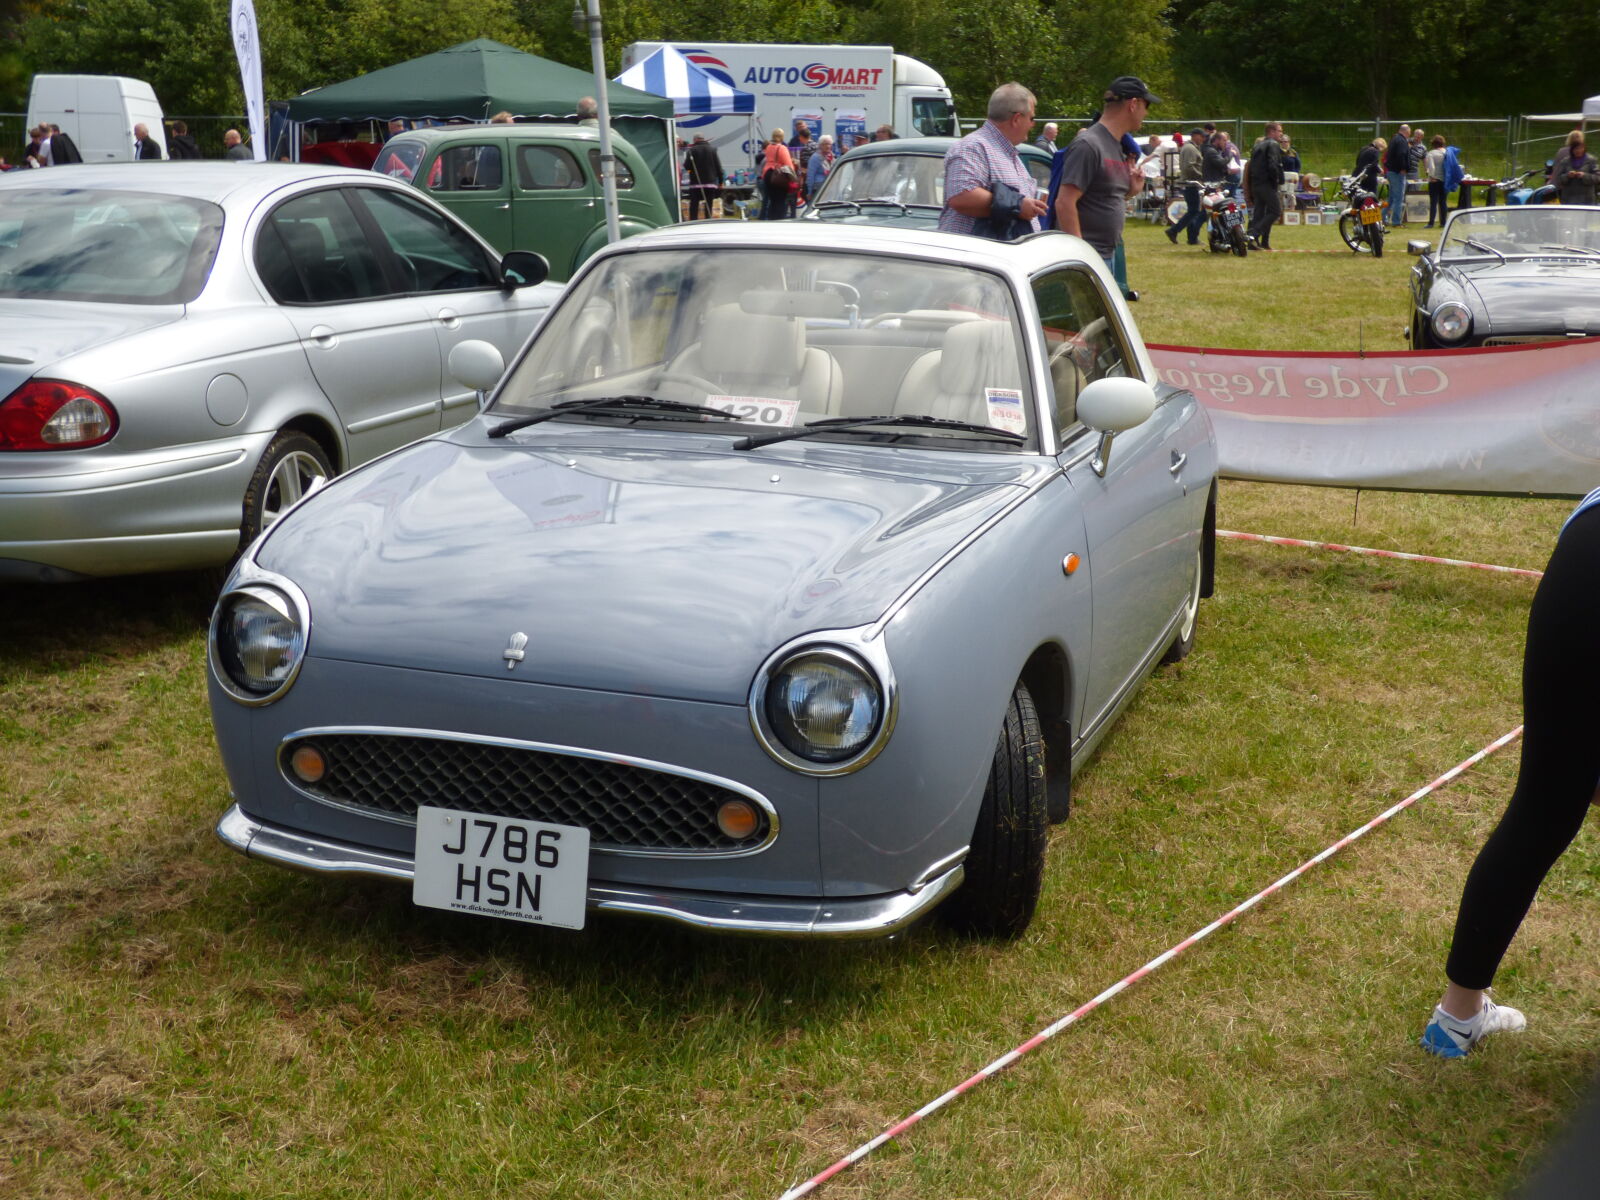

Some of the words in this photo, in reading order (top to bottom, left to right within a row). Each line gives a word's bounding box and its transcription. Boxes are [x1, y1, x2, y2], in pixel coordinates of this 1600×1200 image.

[744, 63, 883, 89] AUTOSMART
[443, 819, 561, 868] J786
[456, 863, 542, 912] HSN
[451, 902, 543, 920] www.dicksonsofperth.co.uk
